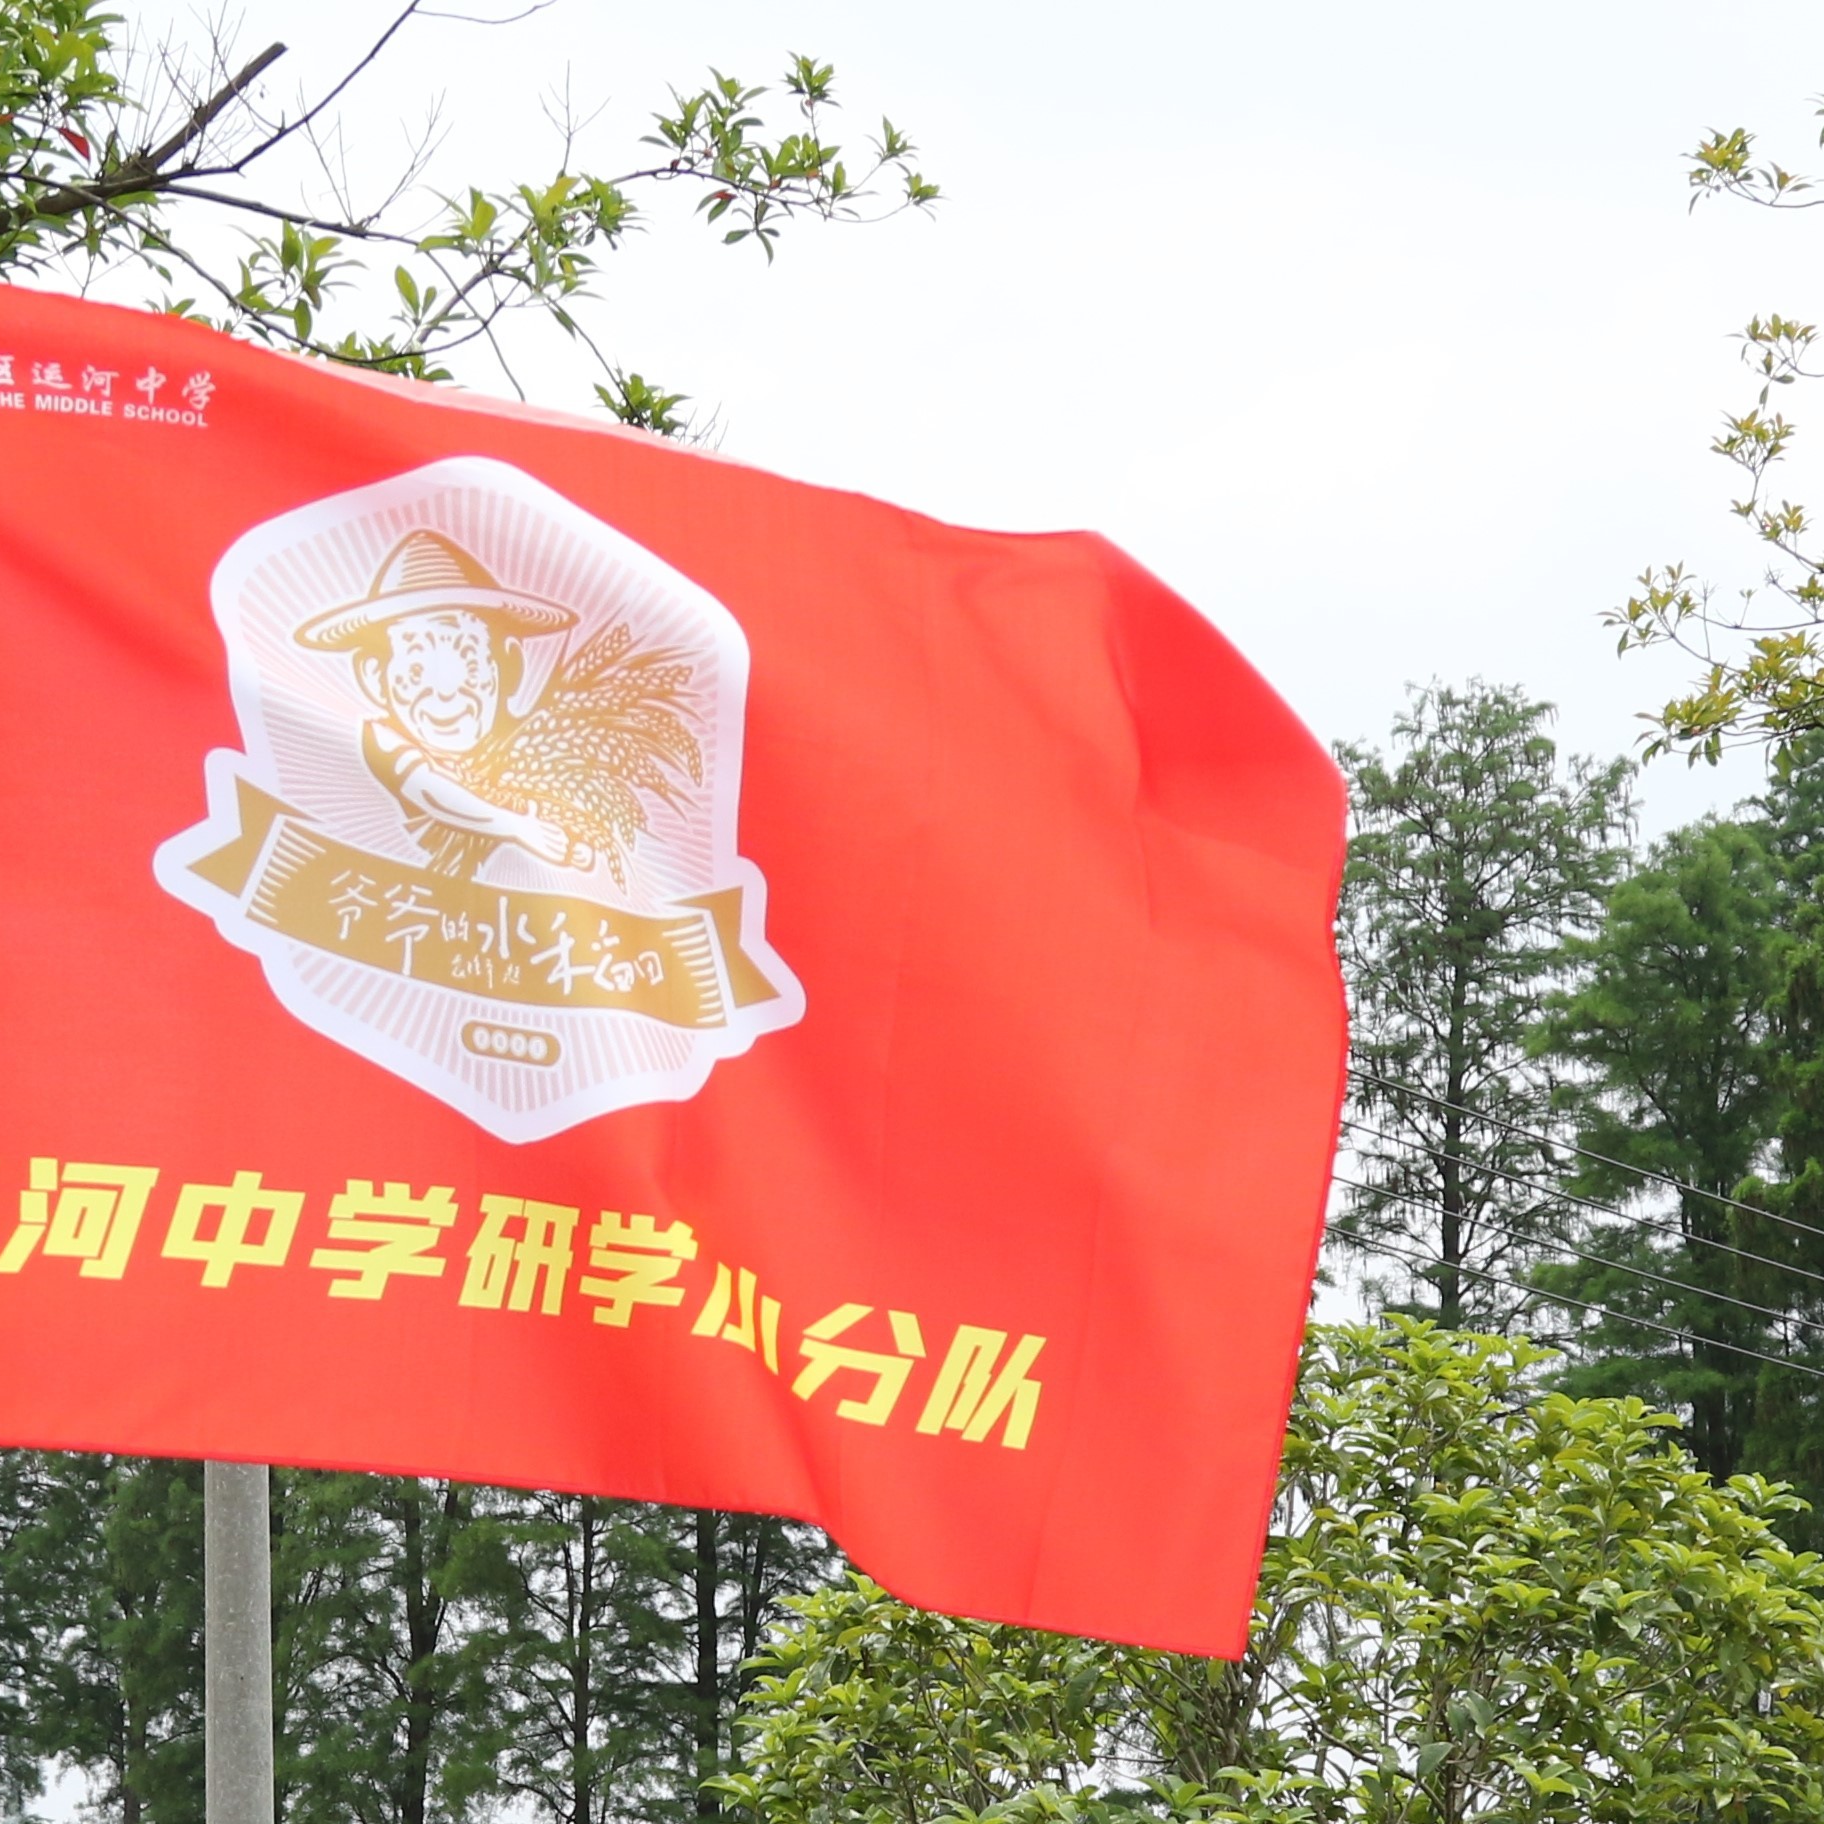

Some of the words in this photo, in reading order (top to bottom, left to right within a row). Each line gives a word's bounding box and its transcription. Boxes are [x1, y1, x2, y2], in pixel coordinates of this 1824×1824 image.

[34, 393, 114, 417] MIDDLE
[123, 402, 210, 428] SCHOOL
[328, 870, 665, 996] 爷爷的水稻田
